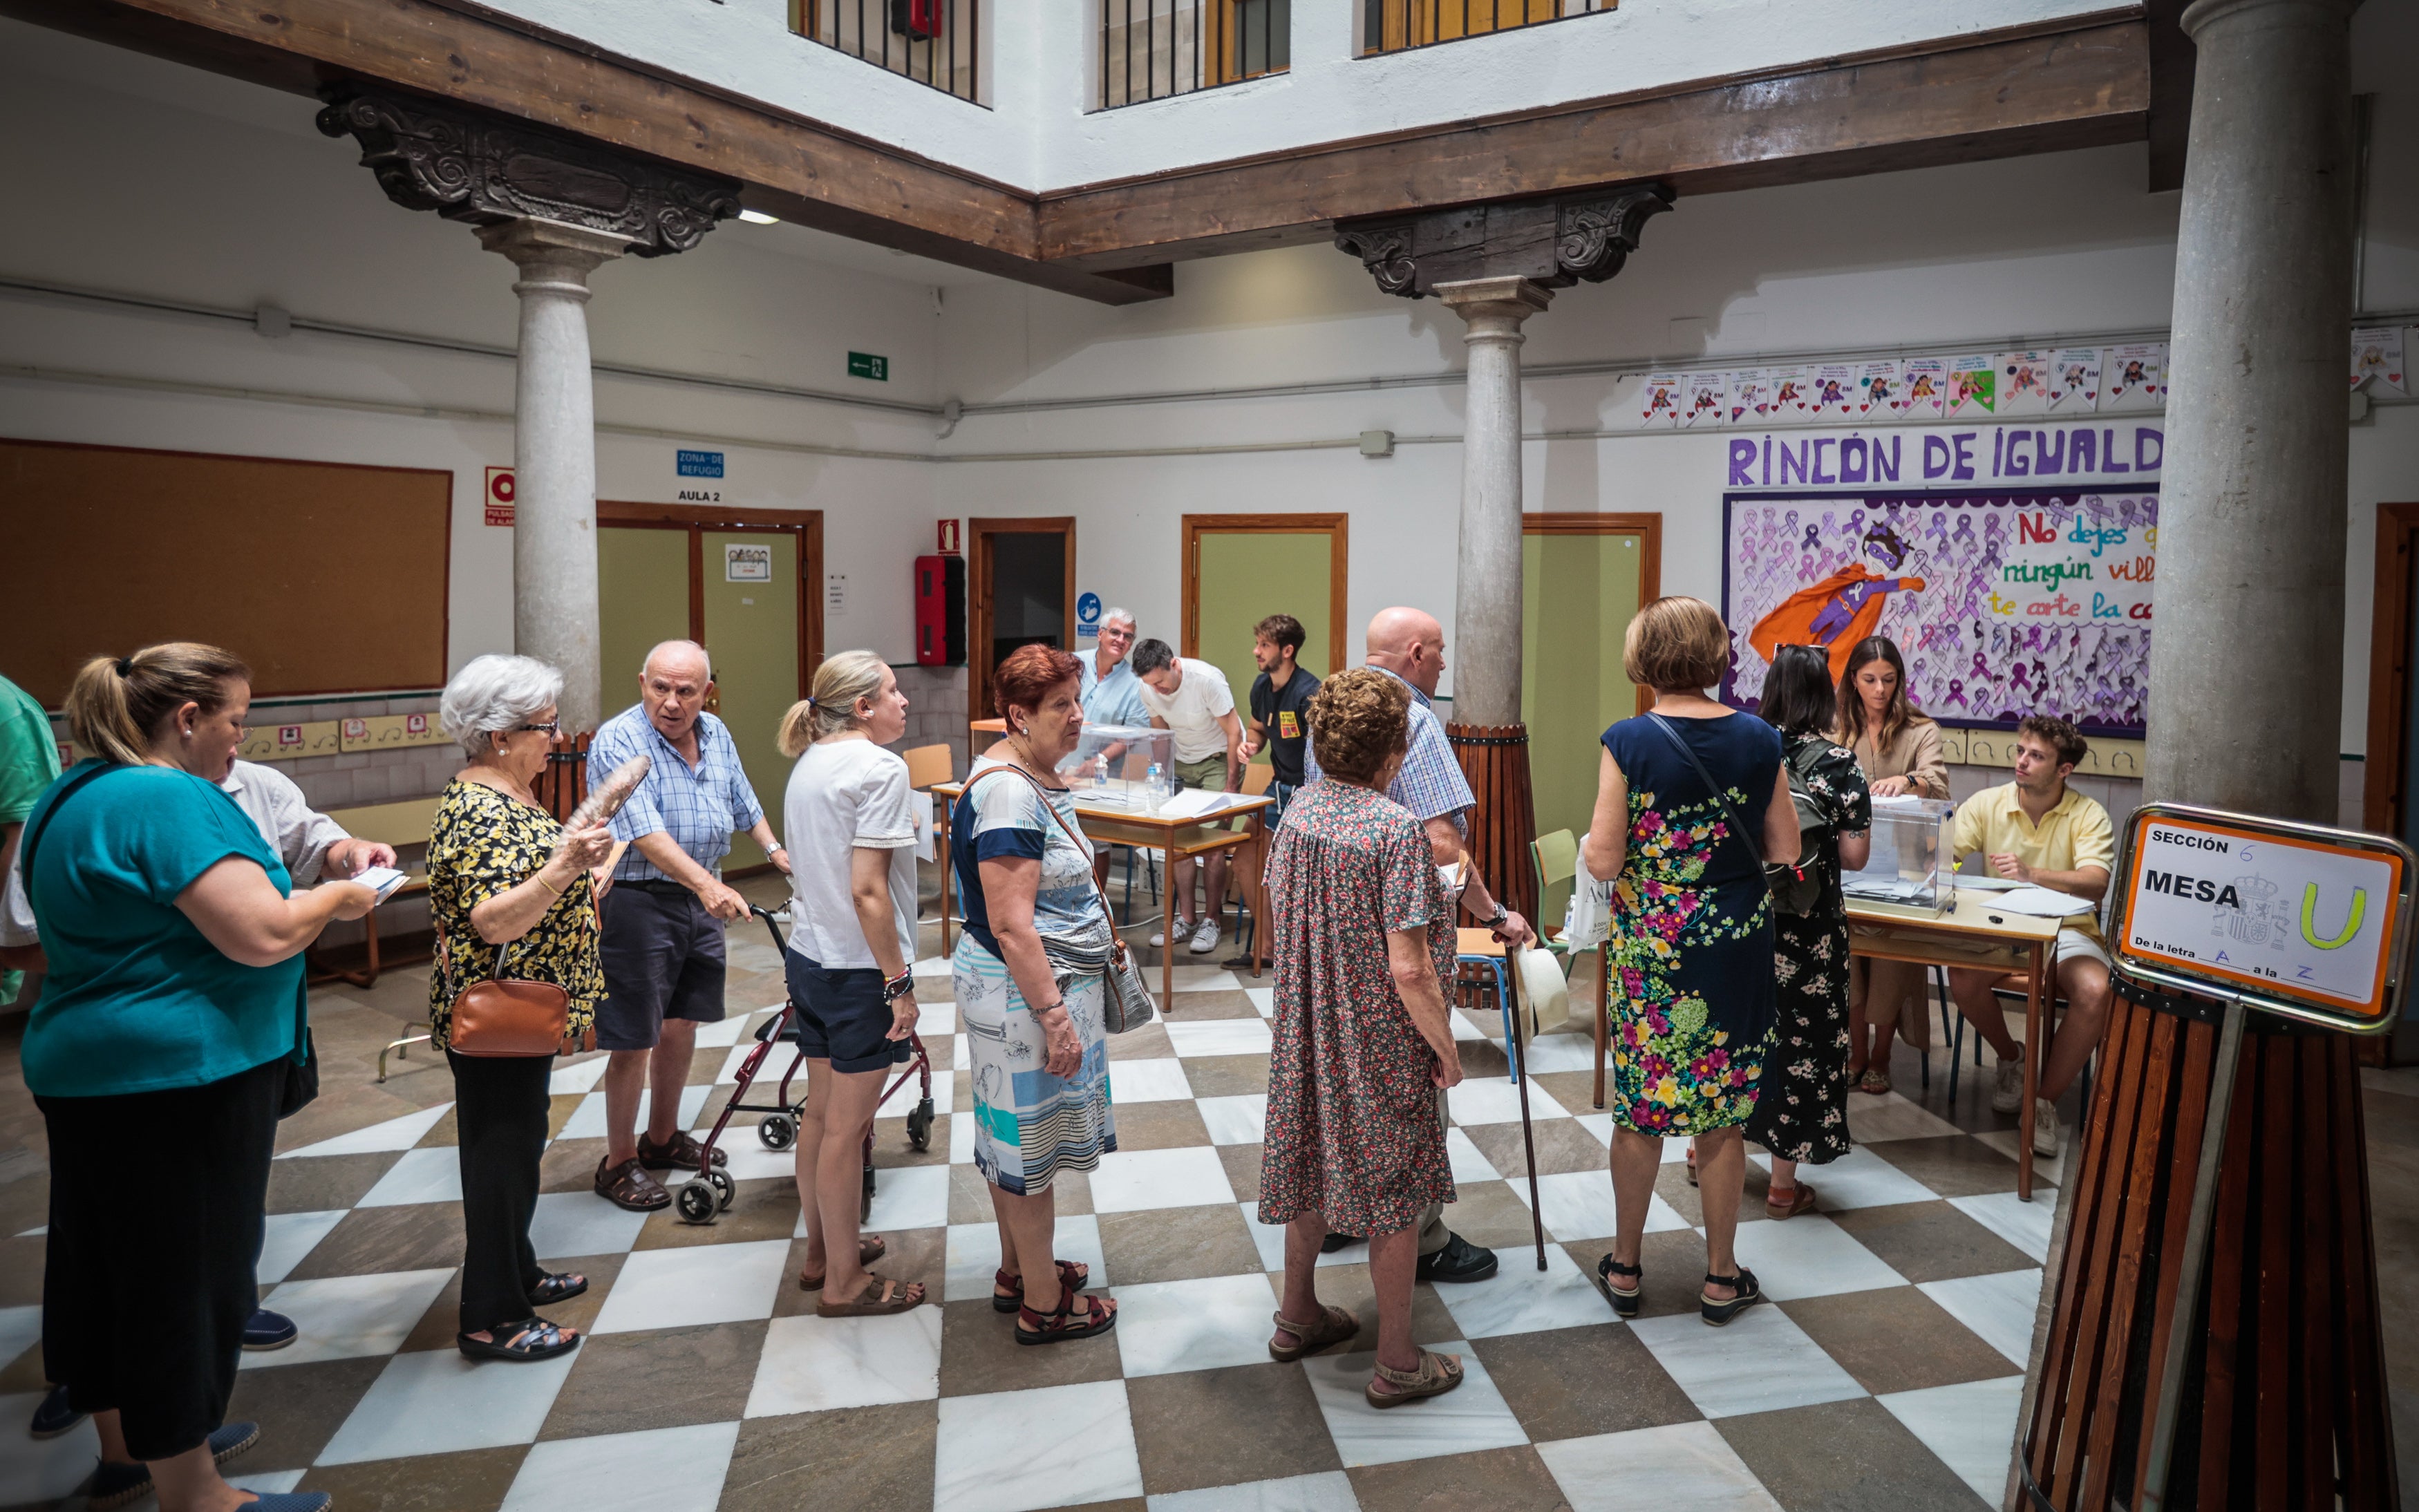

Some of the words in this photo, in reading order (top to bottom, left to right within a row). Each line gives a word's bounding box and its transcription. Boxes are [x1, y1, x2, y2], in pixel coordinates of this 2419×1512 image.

[679, 453, 705, 463] ZONA
[711, 455, 724, 464] DE
[681, 465, 722, 476] REFUGIO
[1923, 433, 1977, 480] DE
[1993, 427, 2164, 477] IGUALD
[679, 490, 710, 502] AULA
[713, 492, 720, 502] 2
[2018, 512, 2057, 545] No
[2068, 514, 2127, 558] dejes
[2004, 556, 2093, 592] ningún
[2108, 556, 2154, 583] vill
[1988, 591, 2017, 615] te
[2026, 593, 2081, 616] corte
[2093, 592, 2122, 618] la
[2152, 830, 2228, 853] SECCIÓN
[2239, 844, 2256, 862] 6
[2145, 869, 2240, 909] MESA
[2300, 881, 2366, 950] U
[2135, 936, 2149, 947] De
[2153, 941, 2164, 950] la
[2167, 945, 2196, 958] letra
[2215, 949, 2230, 963] A
[2265, 967, 2277, 978] la
[2297, 965, 2315, 981] Z
